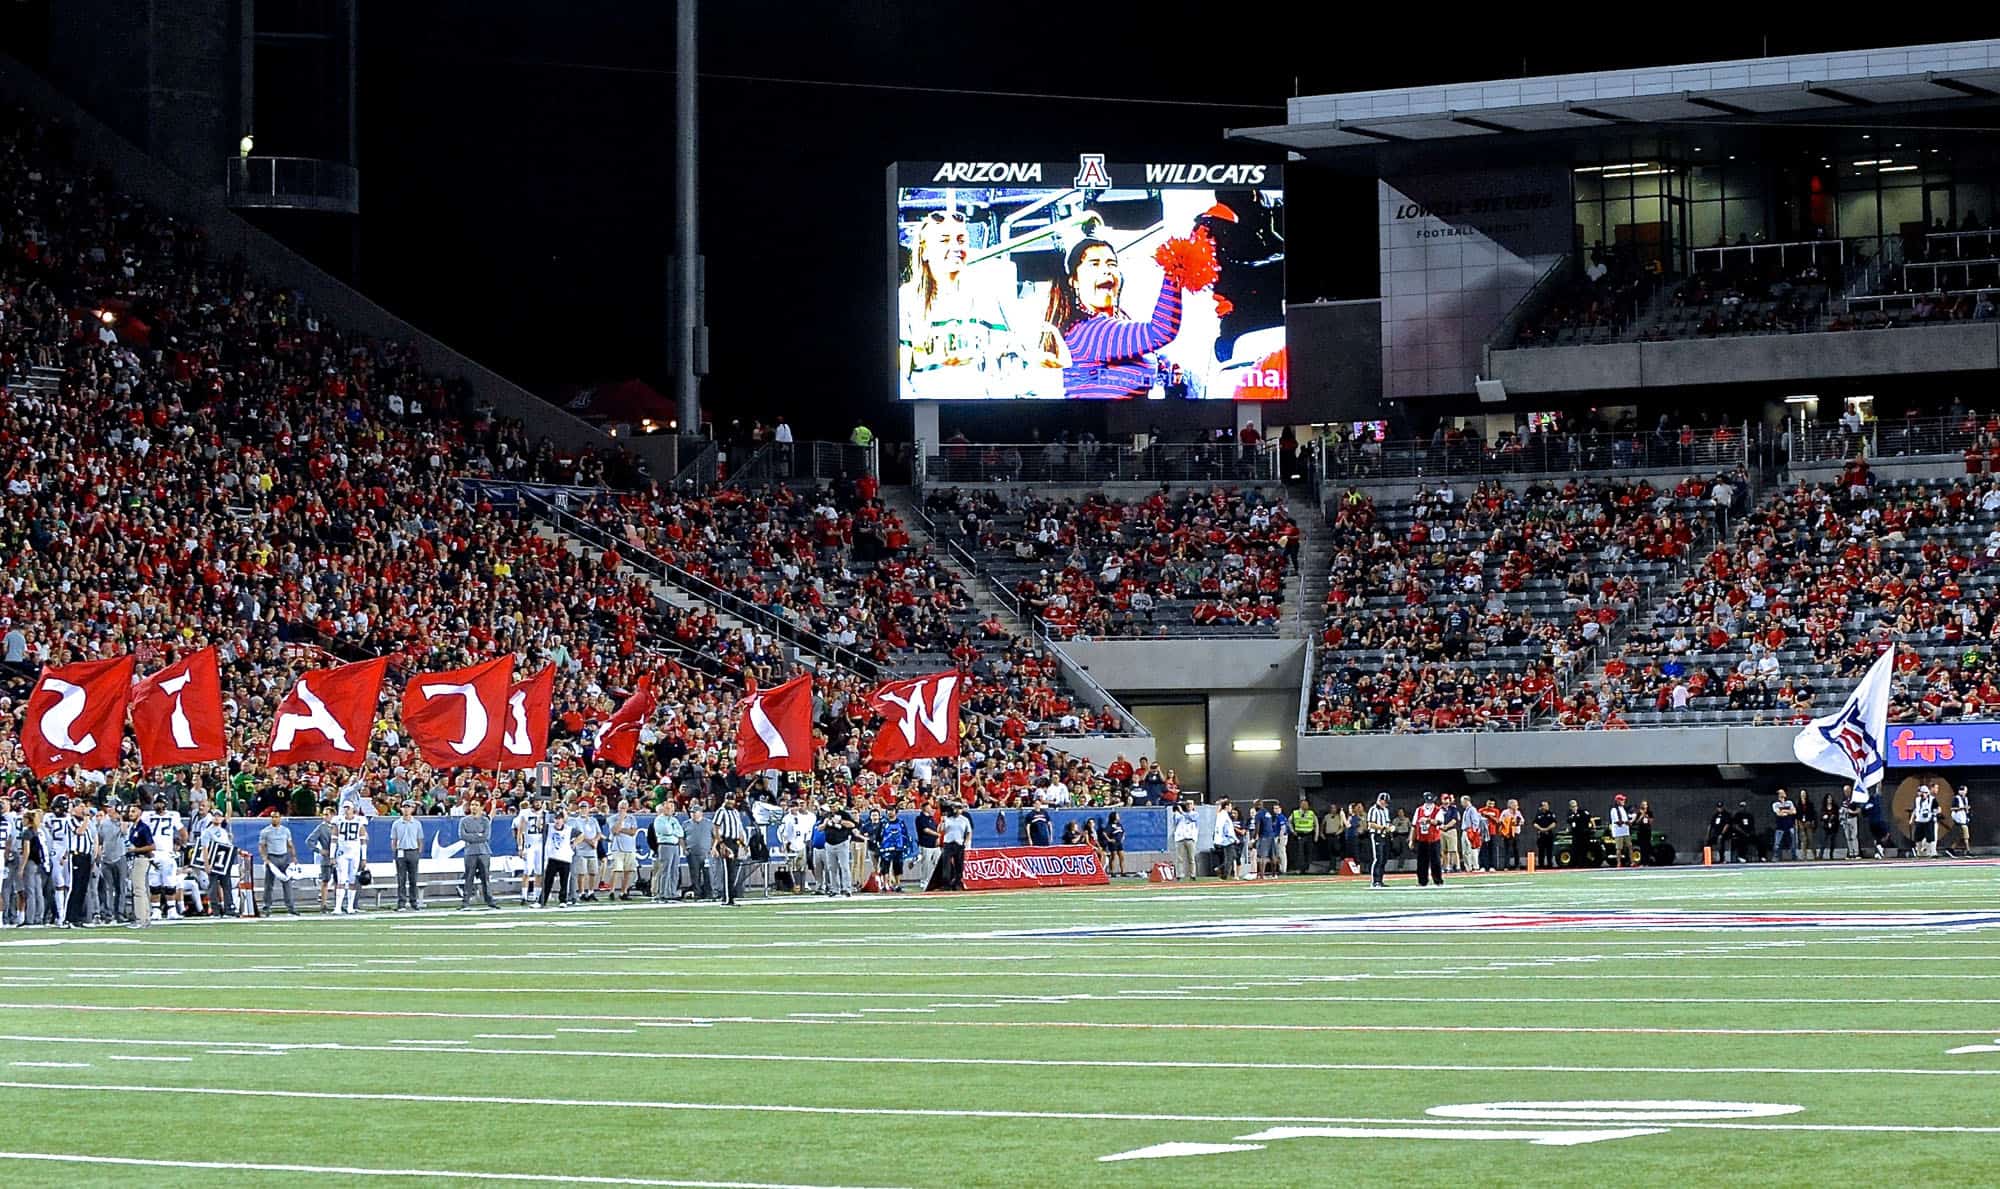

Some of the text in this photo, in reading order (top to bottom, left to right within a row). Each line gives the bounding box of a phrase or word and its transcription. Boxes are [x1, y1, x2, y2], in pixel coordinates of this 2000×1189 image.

[932, 153, 1267, 190] ARIZONA A WILDCATS
[1416, 226, 1475, 239] FOOTBALL
[150, 817, 172, 836] 72
[340, 822, 359, 841] 49
[1025, 854, 1097, 877] WILDCATS
